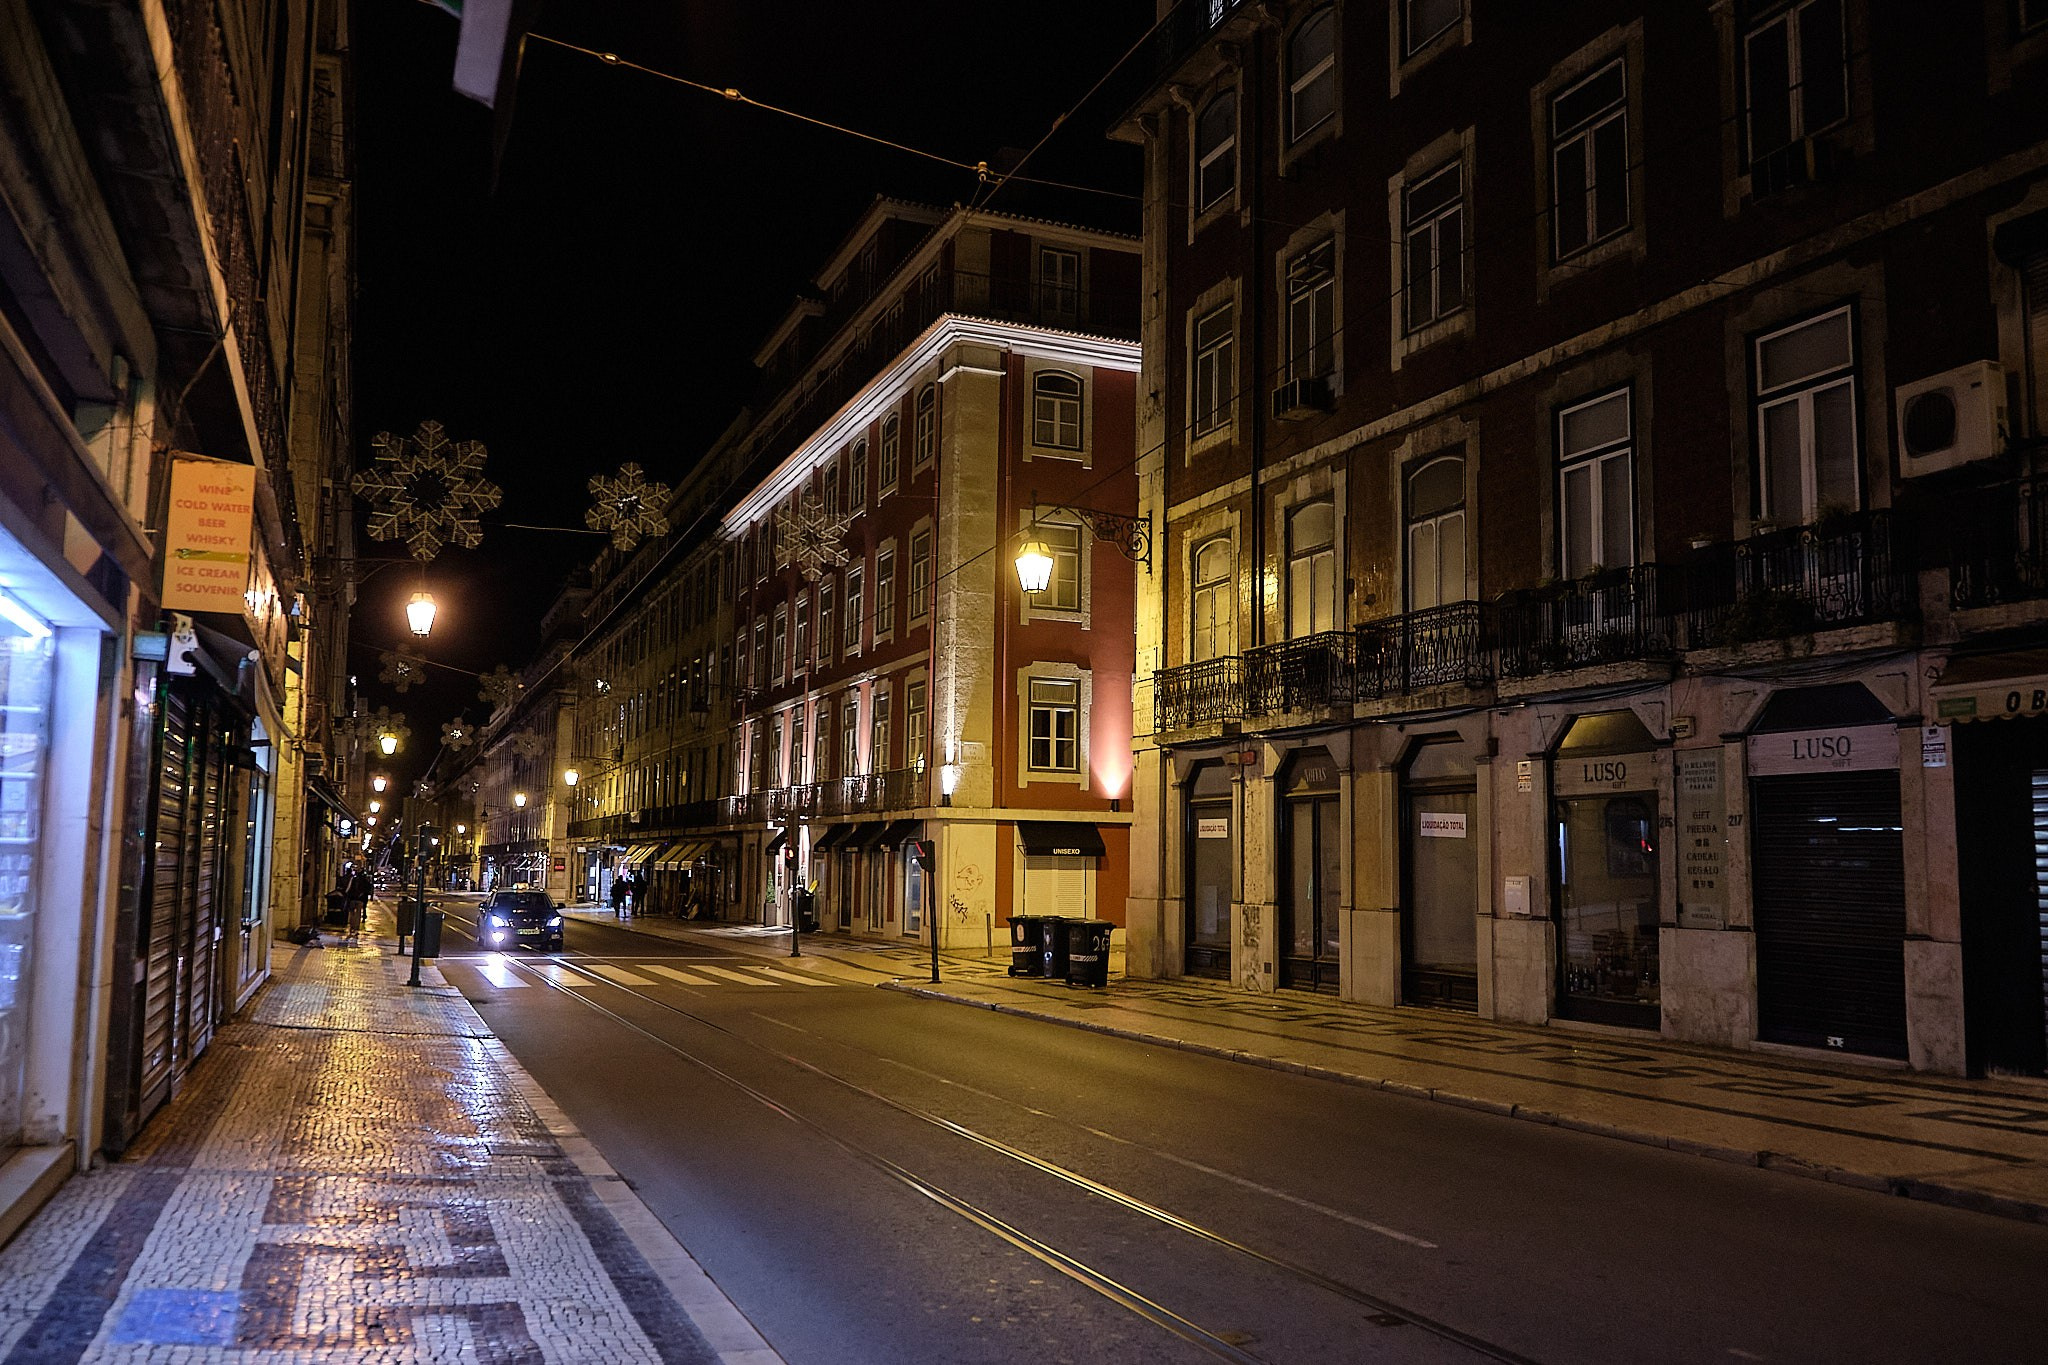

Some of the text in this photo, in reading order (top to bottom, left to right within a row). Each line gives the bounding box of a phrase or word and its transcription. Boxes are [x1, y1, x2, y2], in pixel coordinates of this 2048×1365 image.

[199, 484, 232, 496] WINE
[176, 500, 250, 514] COLD WATER
[198, 518, 226, 528] BEER
[186, 533, 235, 546] WHISKY
[177, 566, 240, 579] ICE CREAM
[176, 583, 239, 596] SOUVENIR
[2006, 690, 2048, 712] O B
[1792, 736, 1851, 760] LUSO
[1584, 762, 1626, 782] LUSO
[1692, 810, 1710, 819] GIFT
[1728, 814, 1743, 827] 217
[1450, 821, 1464, 830] TOTAL
[1687, 825, 1717, 833] PRENDA
[1686, 852, 1718, 861] CADEAU
[1688, 866, 1719, 875] REGALO
